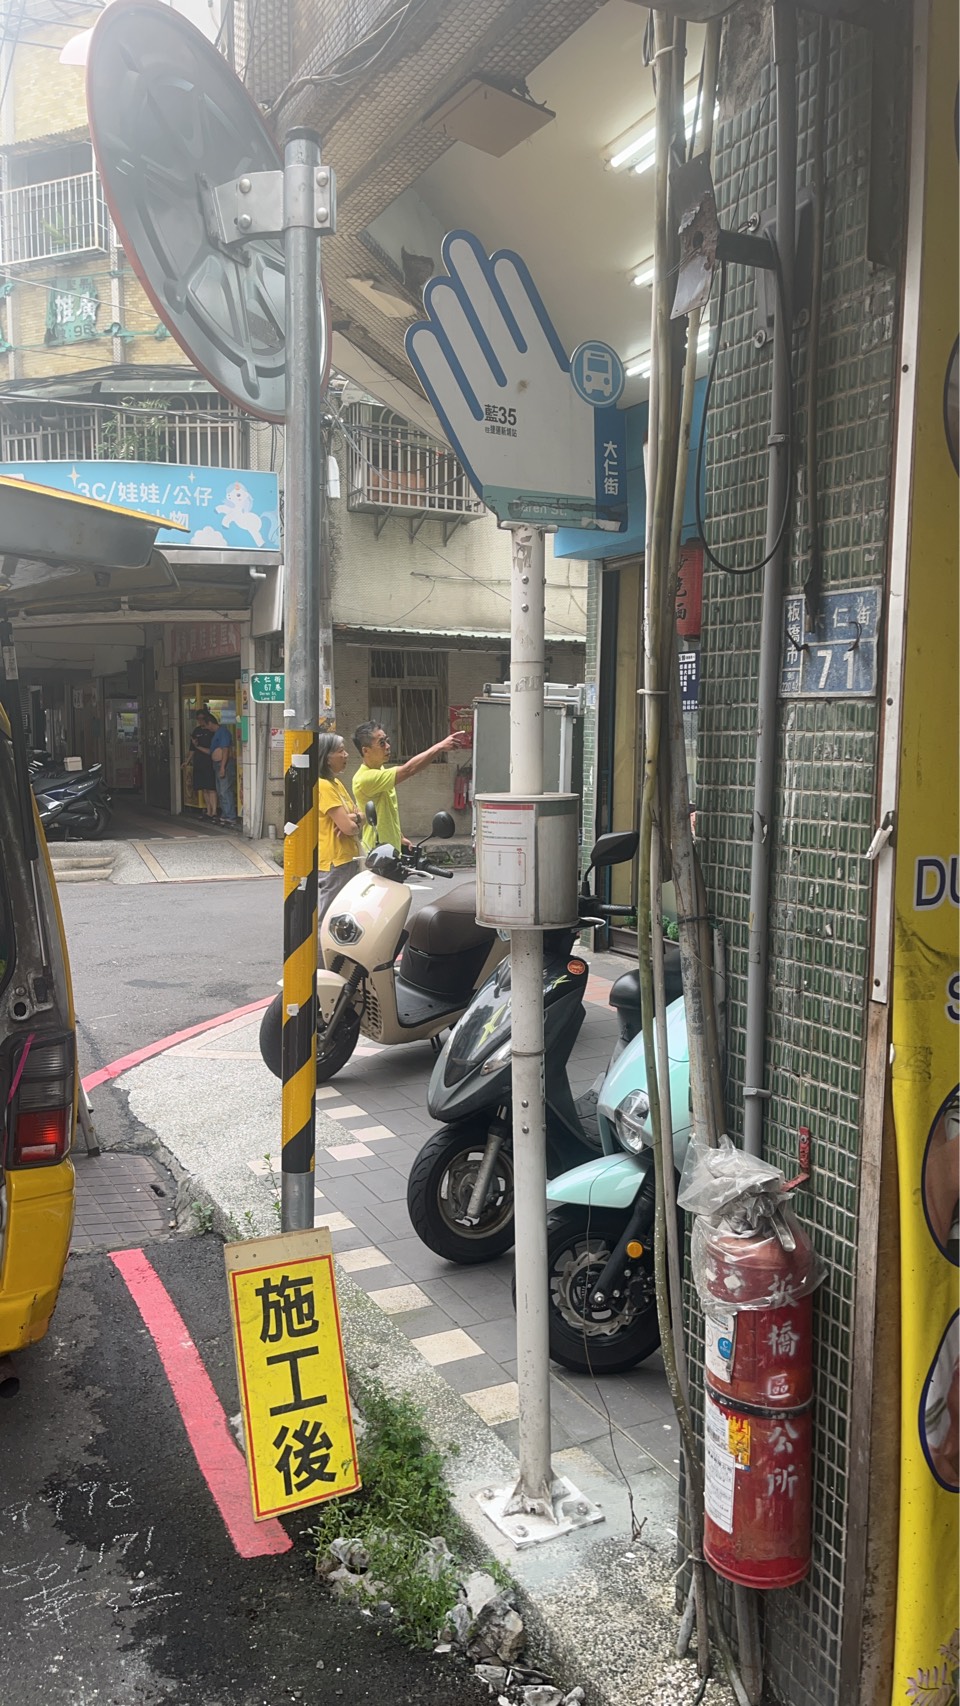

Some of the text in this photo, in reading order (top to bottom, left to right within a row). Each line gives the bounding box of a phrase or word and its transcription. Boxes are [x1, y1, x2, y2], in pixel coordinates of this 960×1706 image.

[484, 404, 517, 426] 藍35
[603, 441, 618, 495] 大仁街
[78, 480, 213, 506] 3C/娃娃/公仔
[254, 676, 281, 684] 大仁街
[817, 648, 855, 689] 71
[255, 1275, 337, 1496] 施工後
